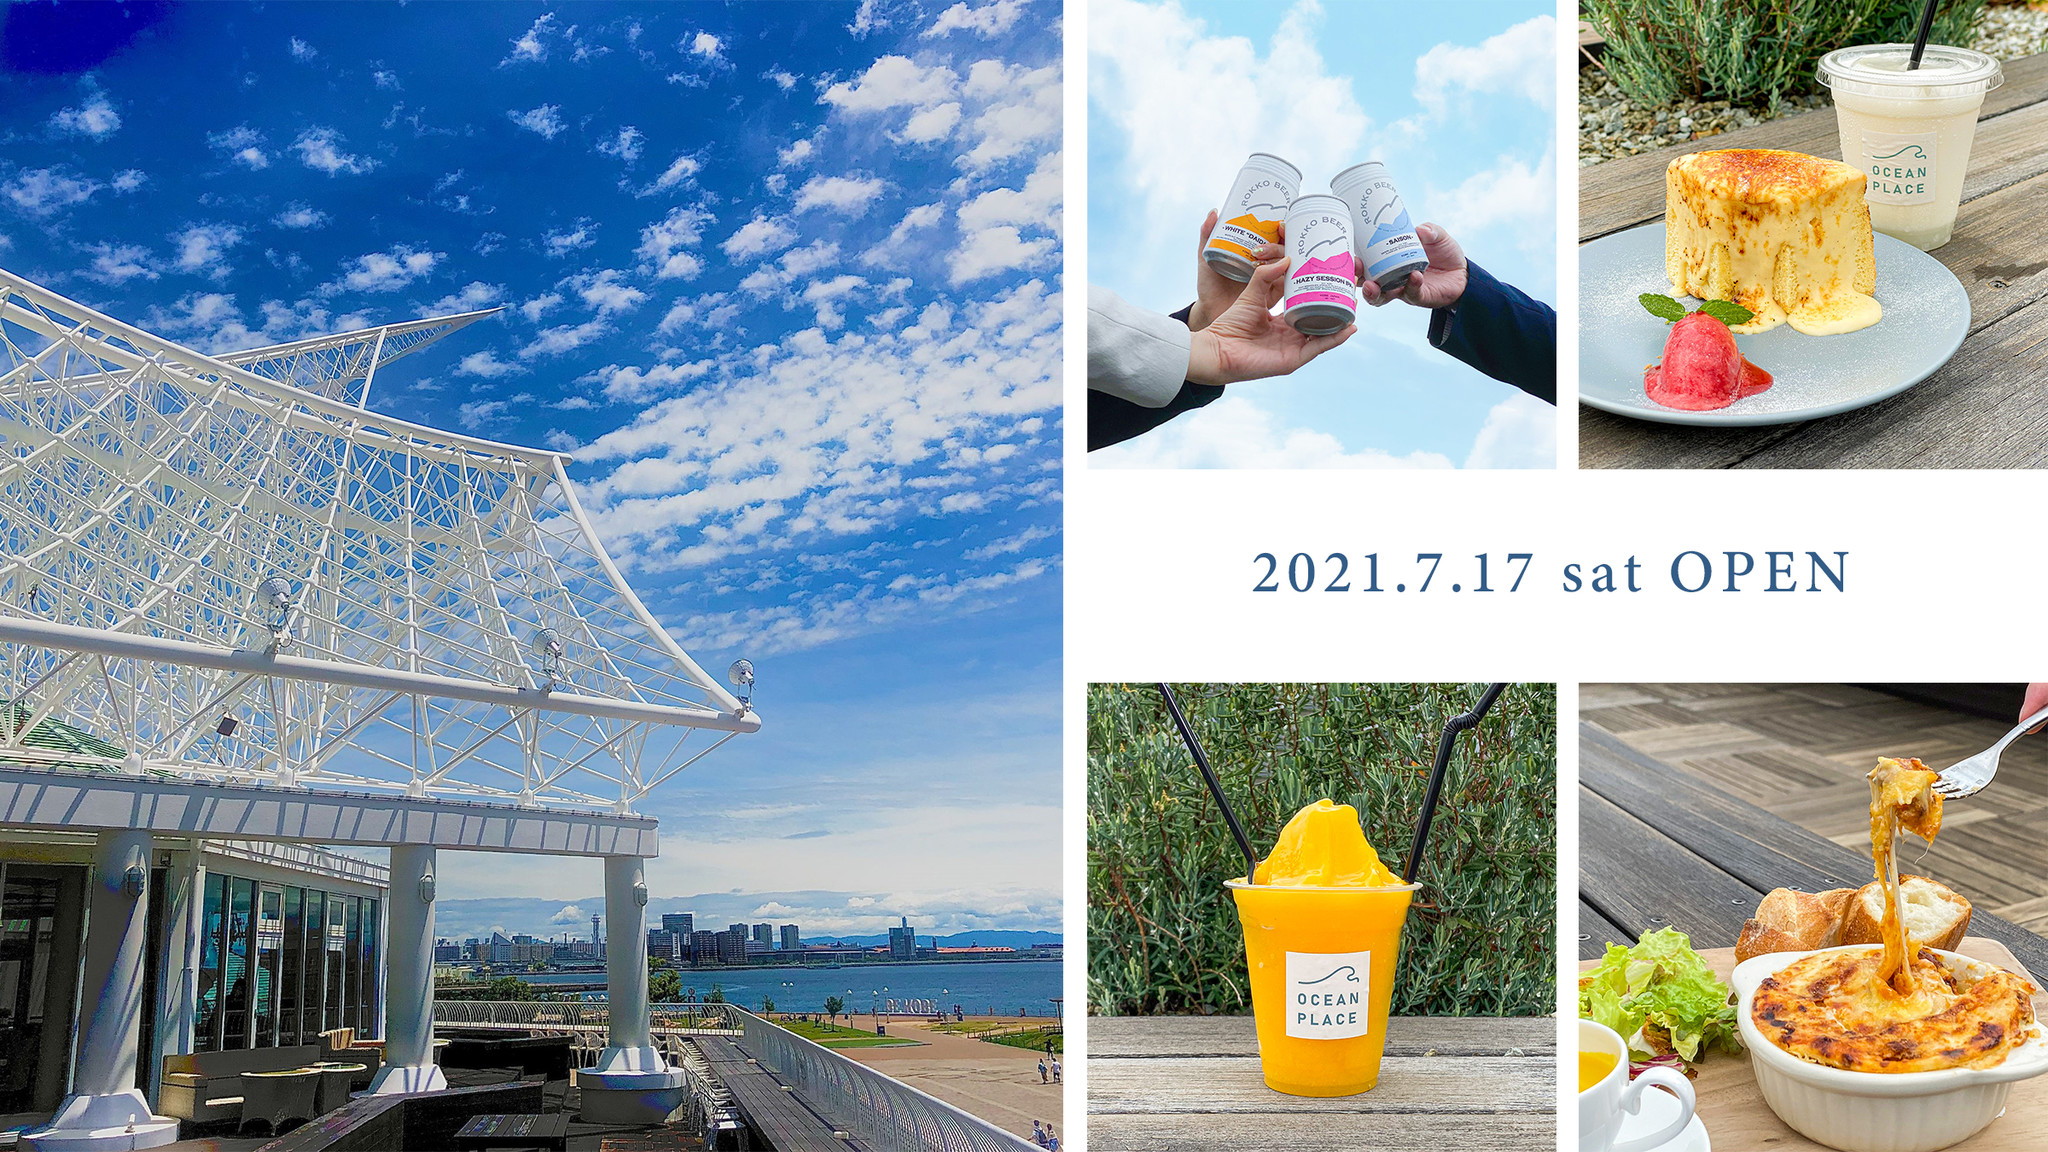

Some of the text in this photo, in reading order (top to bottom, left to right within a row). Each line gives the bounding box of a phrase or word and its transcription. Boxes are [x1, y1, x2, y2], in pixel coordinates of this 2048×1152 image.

[1872, 165, 1927, 179] OCEAN
[1241, 180, 1270, 207] ROKKO
[1872, 181, 1925, 195] PLACE
[1361, 187, 1373, 225] ROKKO
[1224, 225, 1246, 237] WHITE
[1298, 219, 1318, 256] ROKKO
[1322, 216, 1347, 235] BEER
[1316, 275, 1345, 285] SESSION
[1297, 991, 1359, 1006] OCEAN
[1297, 1012, 1357, 1026] PLACE
